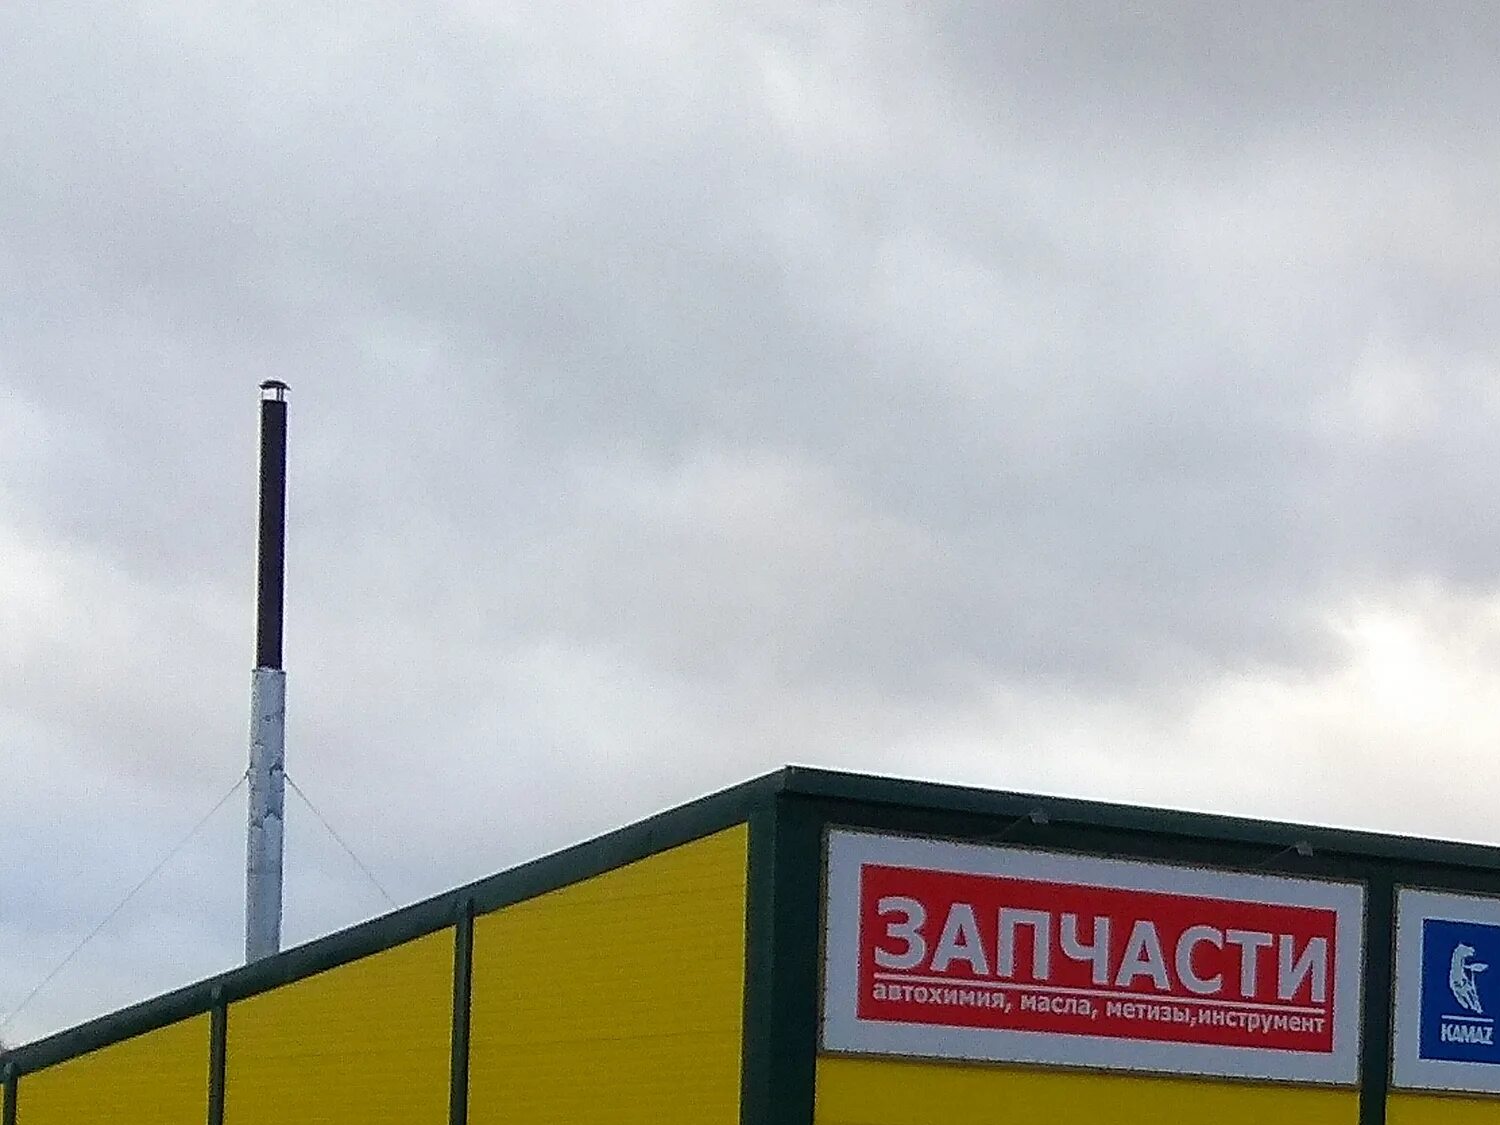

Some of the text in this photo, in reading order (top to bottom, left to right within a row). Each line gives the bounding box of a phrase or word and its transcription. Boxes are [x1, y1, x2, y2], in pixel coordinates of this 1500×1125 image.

[873, 895, 1328, 1002] ЗАПЧАСТИ
[872, 982, 1012, 1014] автохимия,
[1020, 993, 1098, 1020] масла,
[1440, 1023, 1494, 1045] KAMAZ
